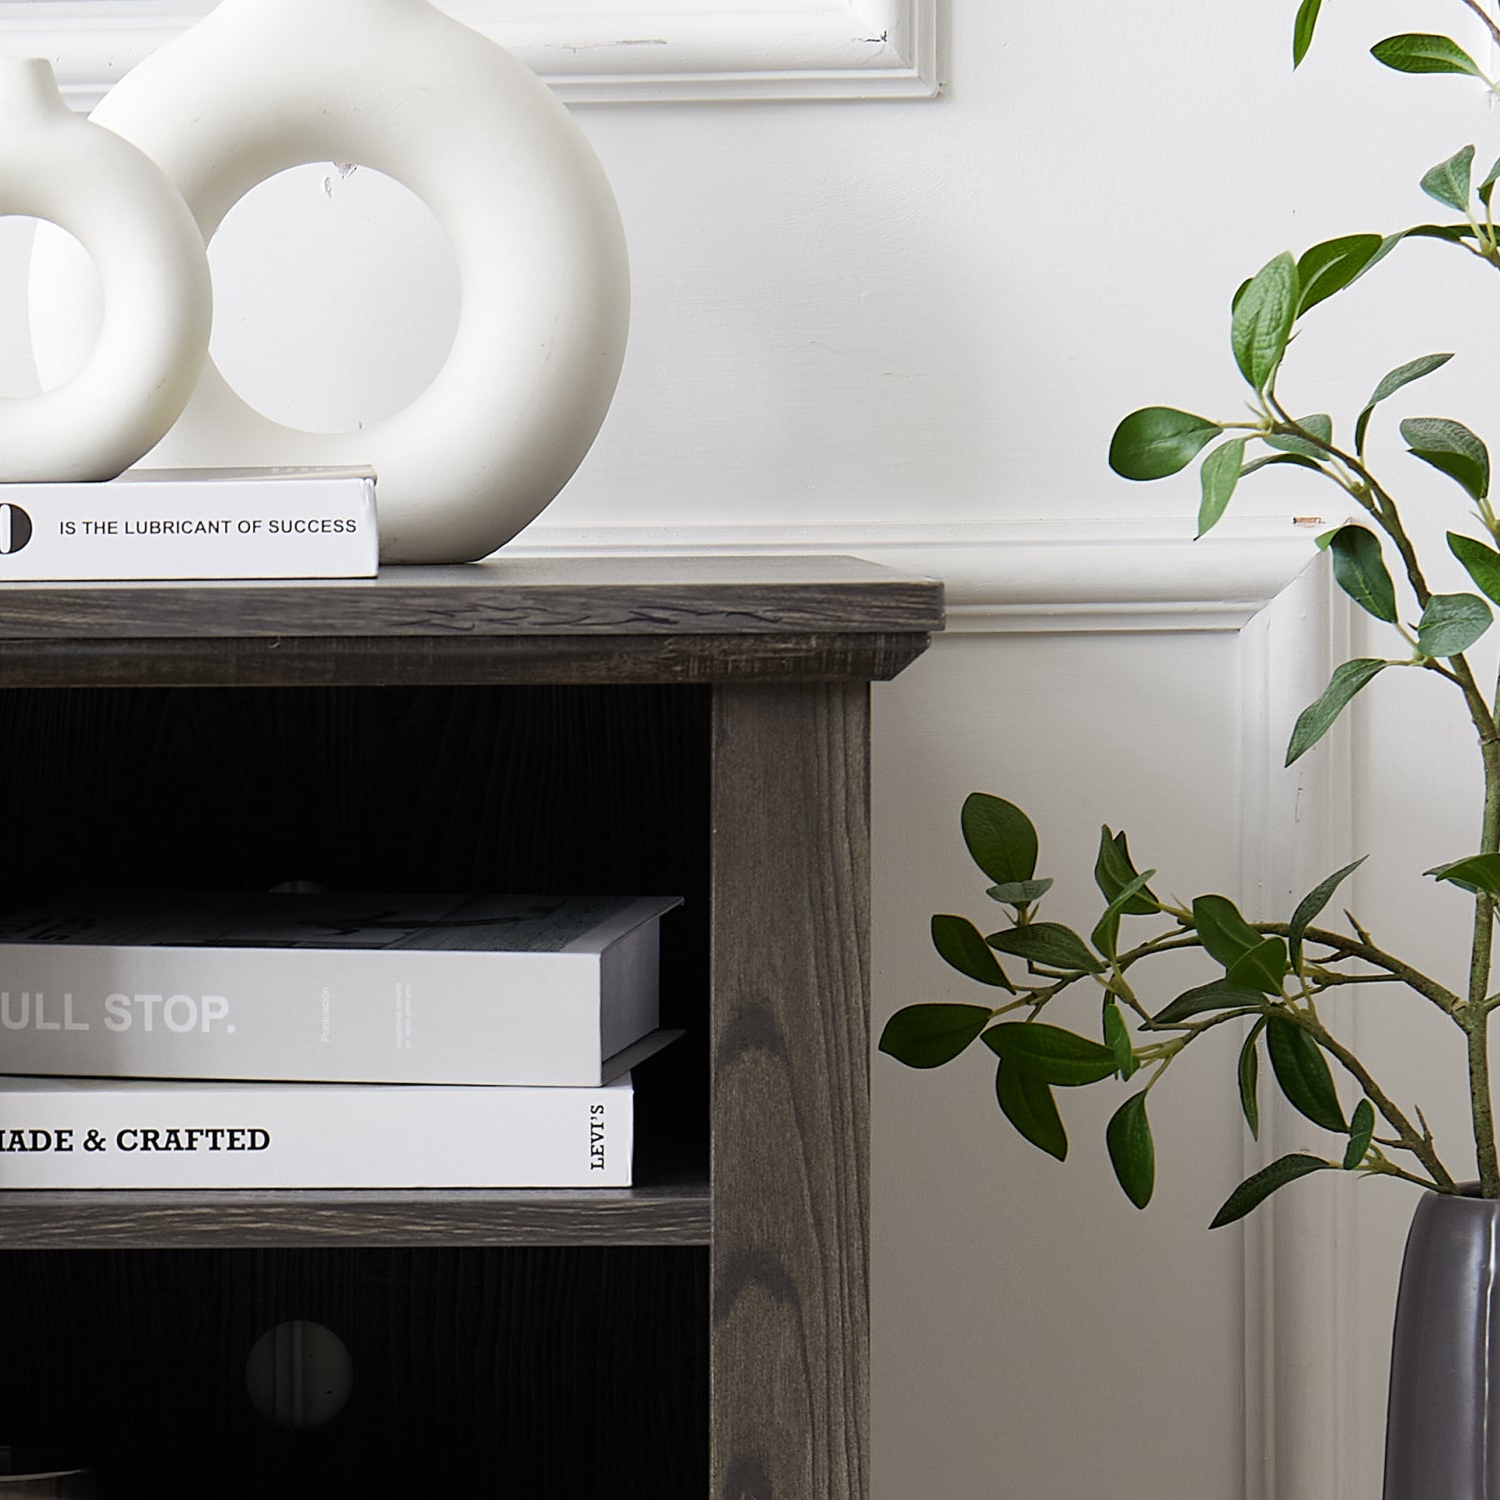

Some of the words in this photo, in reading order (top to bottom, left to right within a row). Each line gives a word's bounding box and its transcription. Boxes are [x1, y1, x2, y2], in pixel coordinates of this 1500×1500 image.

[59, 520, 76, 535] IS
[81, 520, 119, 535] THE
[124, 519, 233, 535] LUBRICANT
[237, 519, 263, 534] OF
[268, 518, 357, 534] SUCCESS
[103, 993, 236, 1034] STOP.
[82, 1128, 107, 1152] &
[116, 1128, 271, 1152] CRAFTED
[590, 1104, 605, 1171] LEVI'S
